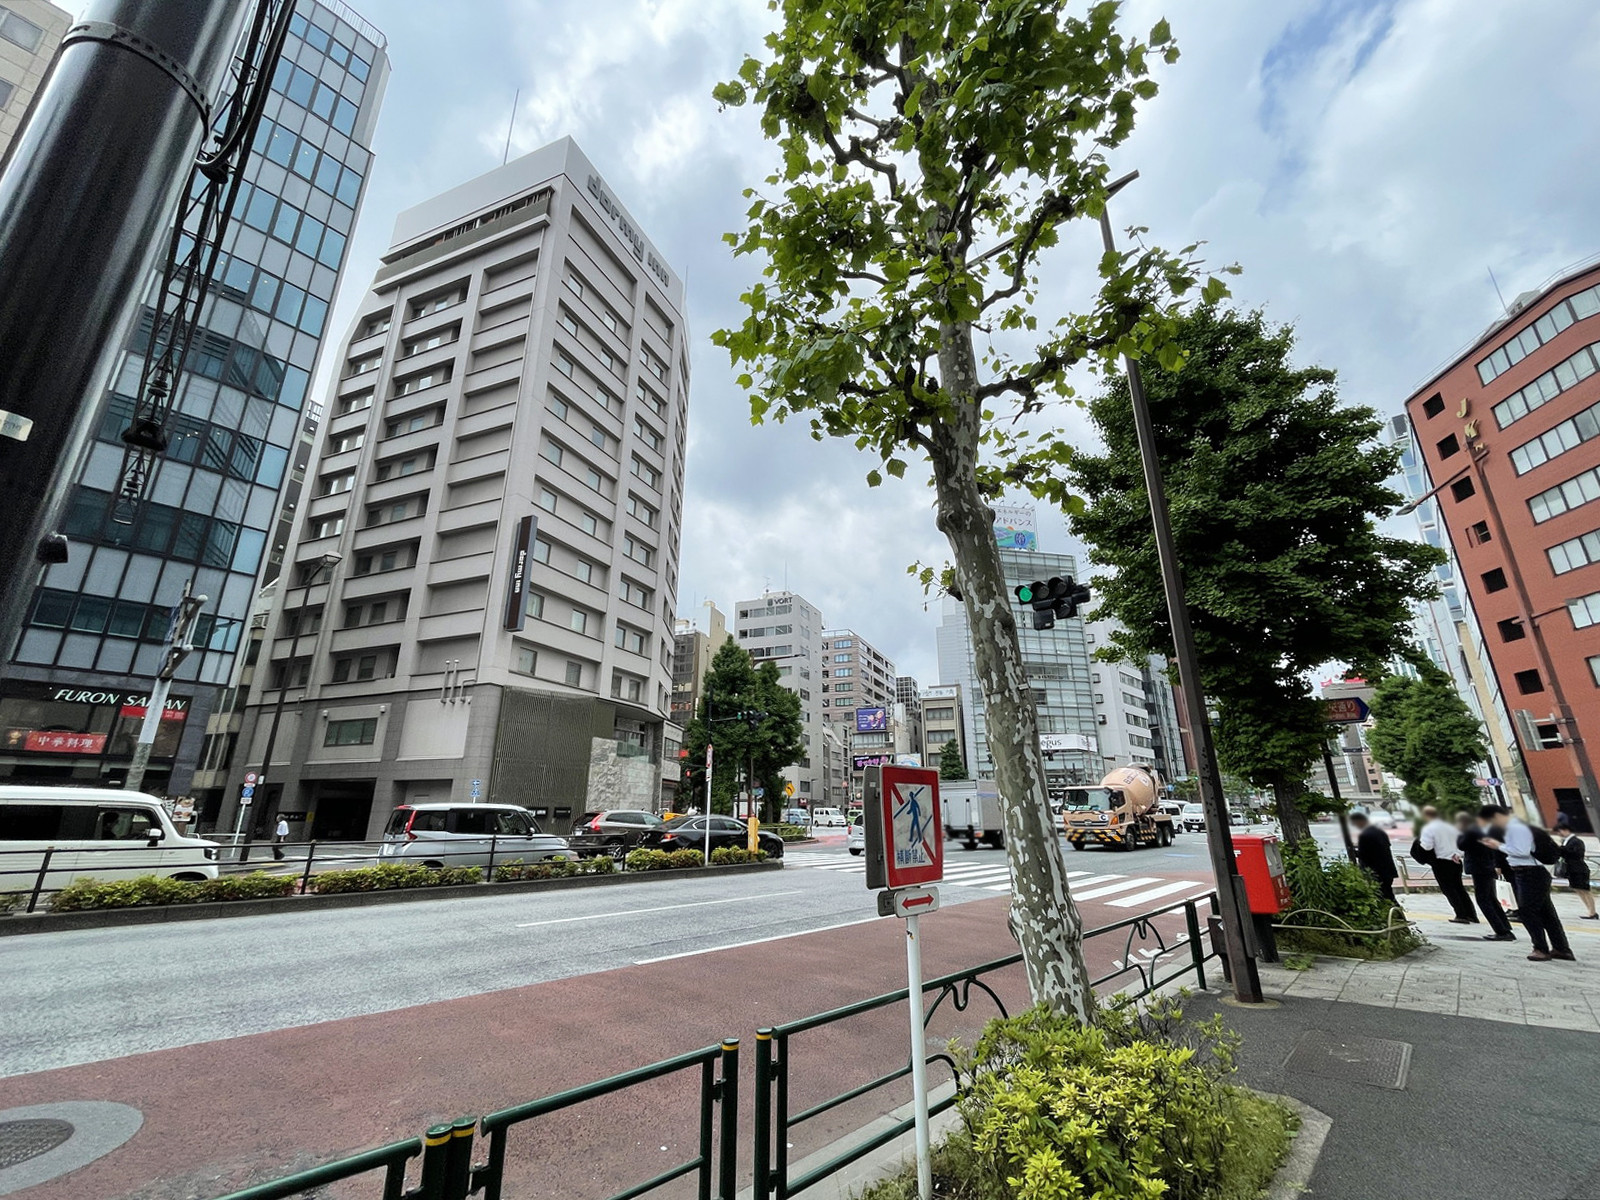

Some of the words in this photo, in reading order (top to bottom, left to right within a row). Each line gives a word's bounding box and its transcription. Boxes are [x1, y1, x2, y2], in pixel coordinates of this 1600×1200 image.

[587, 174, 645, 263] dormy
[647, 251, 670, 288] inn
[514, 549, 527, 579] dormy
[774, 596, 793, 605] VORT
[54, 688, 120, 705] FURON
[123, 695, 187, 711] SAIAN
[37, 735, 95, 749] 中華料理
[1041, 739, 1062, 749] egus
[896, 848, 926, 864] 横断禁止
